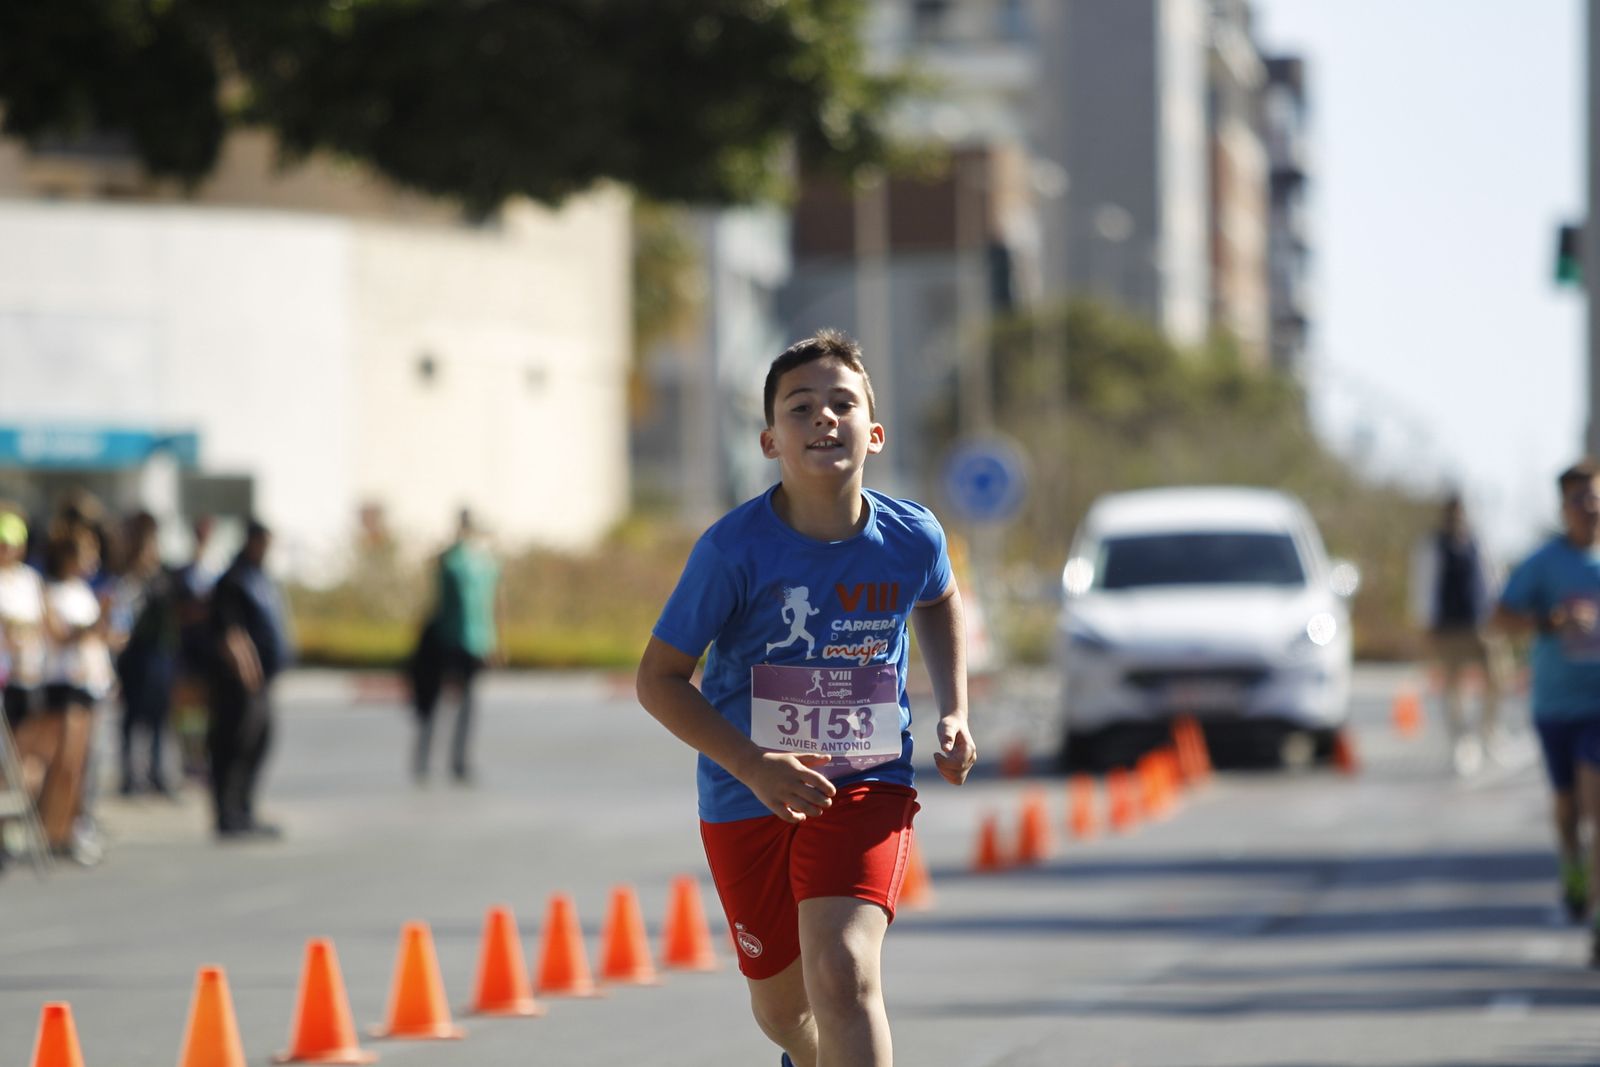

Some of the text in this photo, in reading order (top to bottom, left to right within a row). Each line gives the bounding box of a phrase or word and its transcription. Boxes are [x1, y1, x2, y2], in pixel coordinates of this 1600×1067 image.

[834, 582, 898, 612] VIII
[831, 618, 896, 631] CARRERA
[829, 670, 852, 680] VIII
[777, 704, 874, 740] 3153
[779, 738, 871, 751] JAVIER ANTONIO
